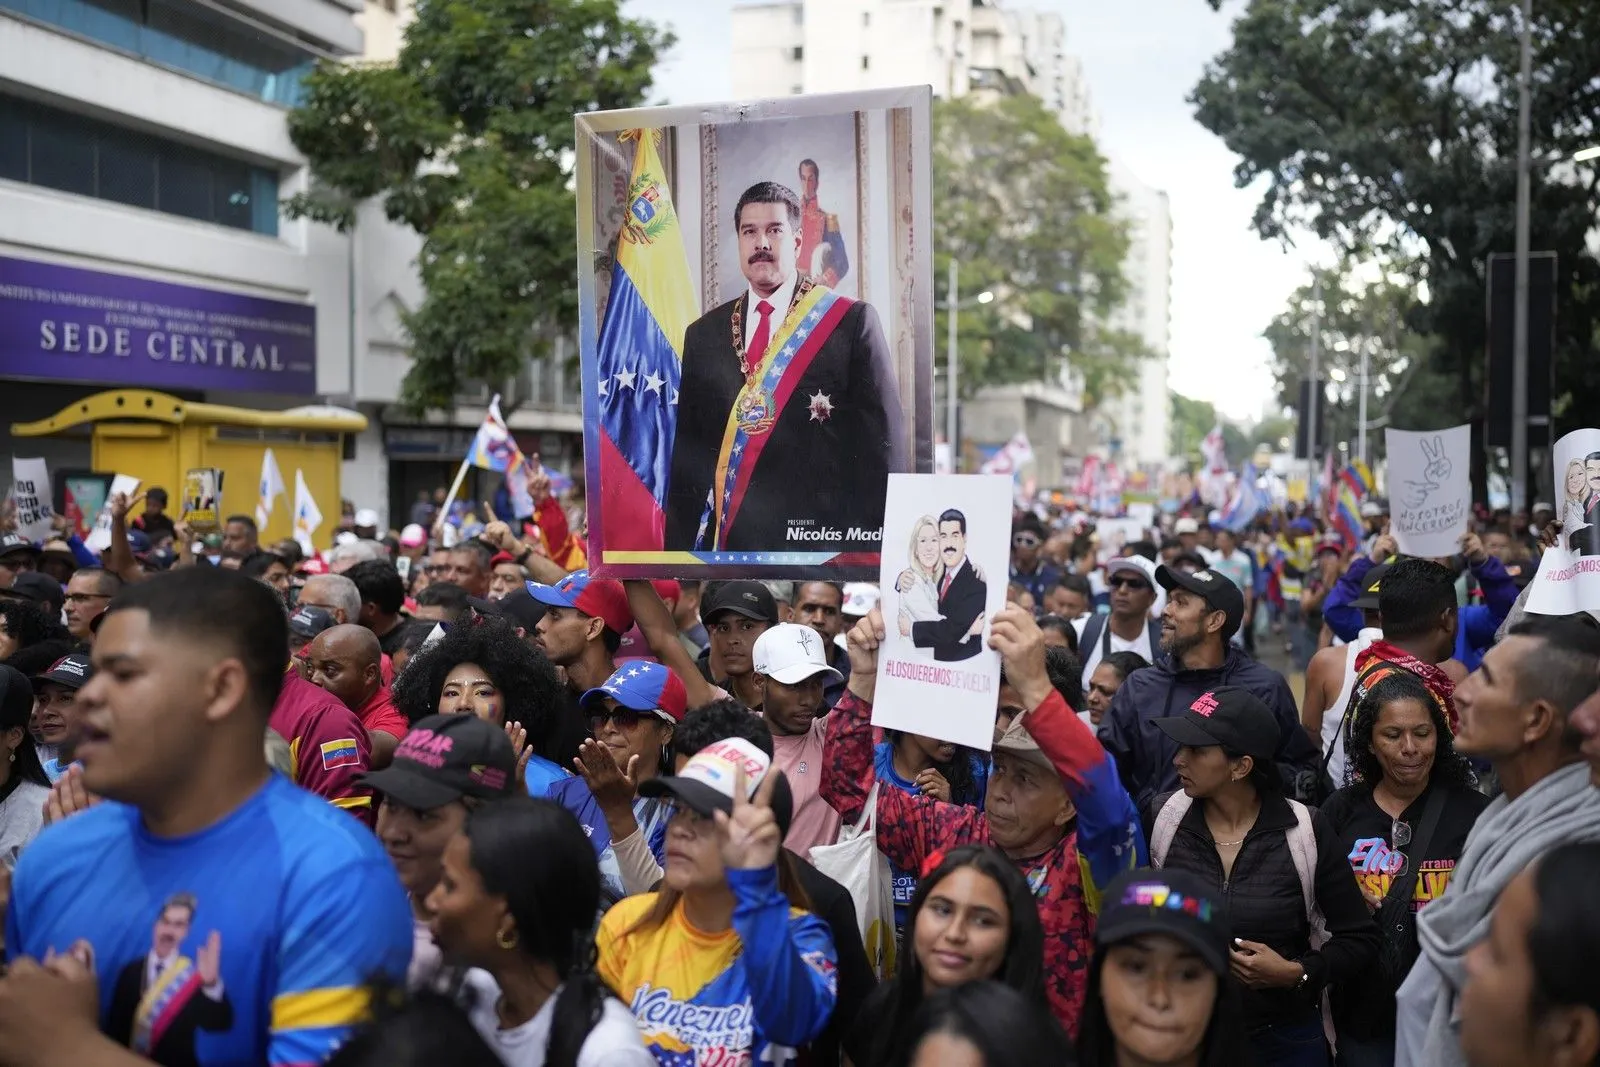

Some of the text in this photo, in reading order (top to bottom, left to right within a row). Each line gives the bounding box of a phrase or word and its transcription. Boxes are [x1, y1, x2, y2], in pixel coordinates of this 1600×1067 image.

[40, 320, 284, 372] SEDE CENTRAL
[786, 526, 843, 541] Nicolás
